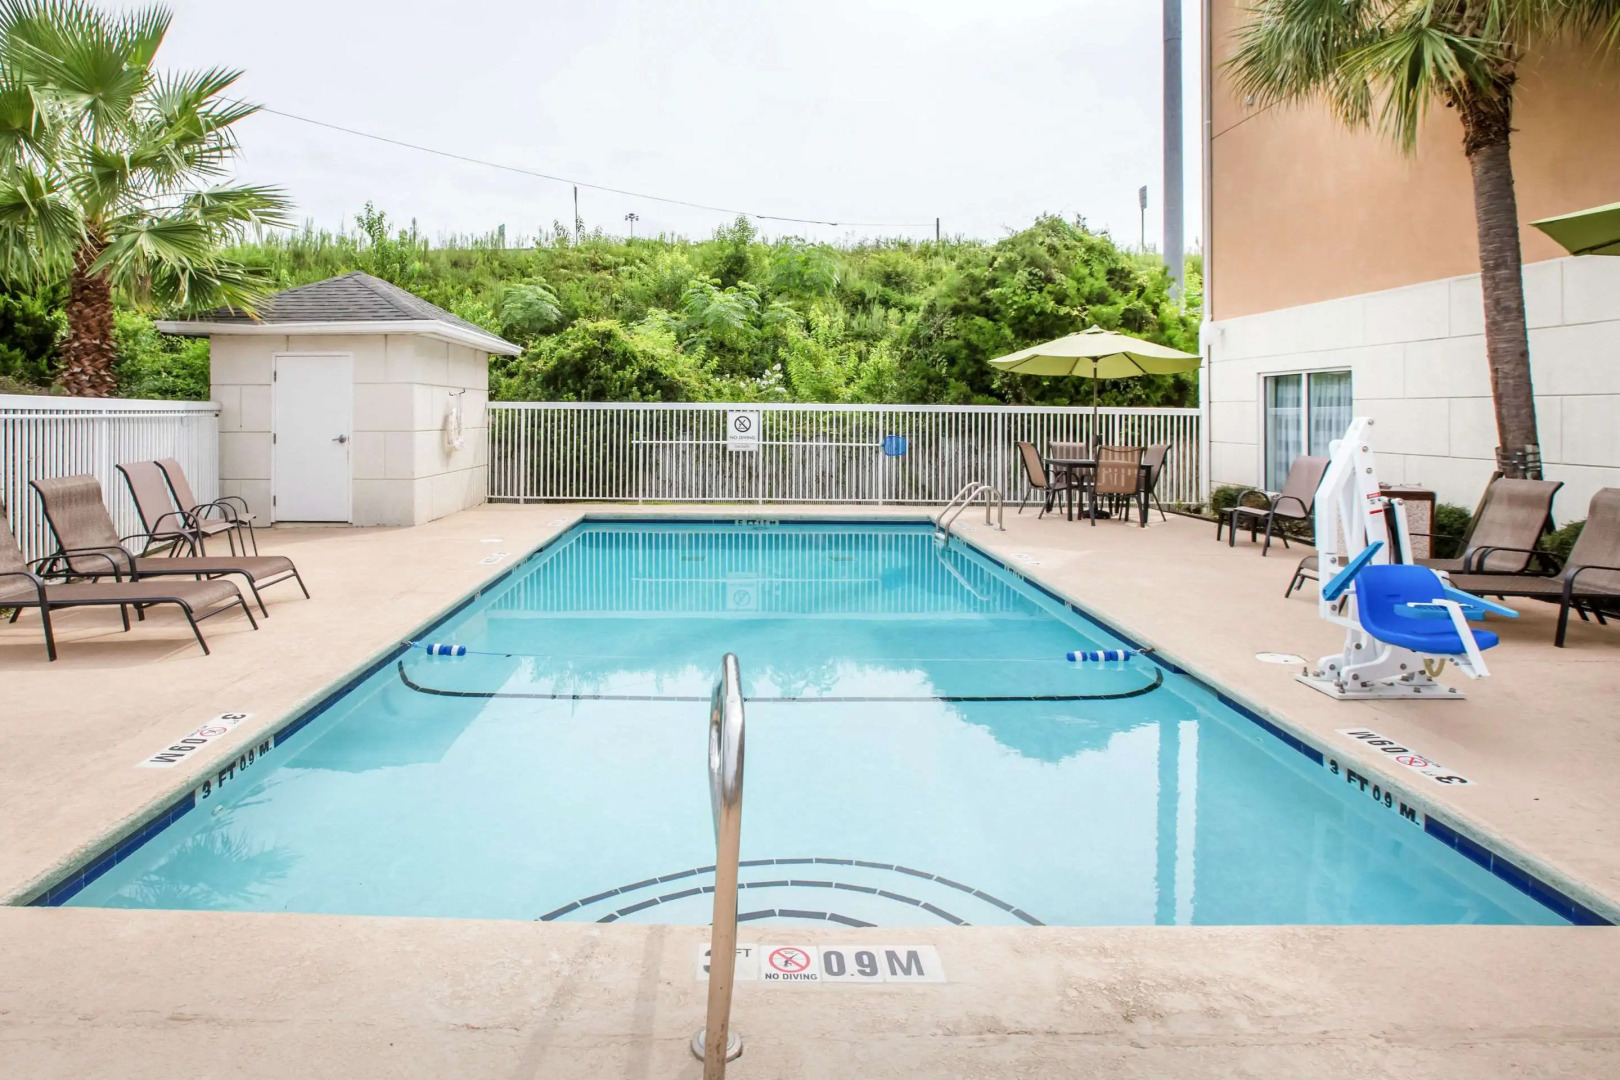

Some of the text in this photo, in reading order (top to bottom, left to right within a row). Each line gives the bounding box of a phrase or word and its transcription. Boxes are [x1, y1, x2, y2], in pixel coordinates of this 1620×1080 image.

[202, 780, 211, 799] 3
[218, 761, 236, 788] FT
[240, 749, 255, 771] 0.9
[1329, 759, 1339, 775] 3
[1347, 768, 1368, 792] FT
[1372, 784, 1392, 808] 0.9
